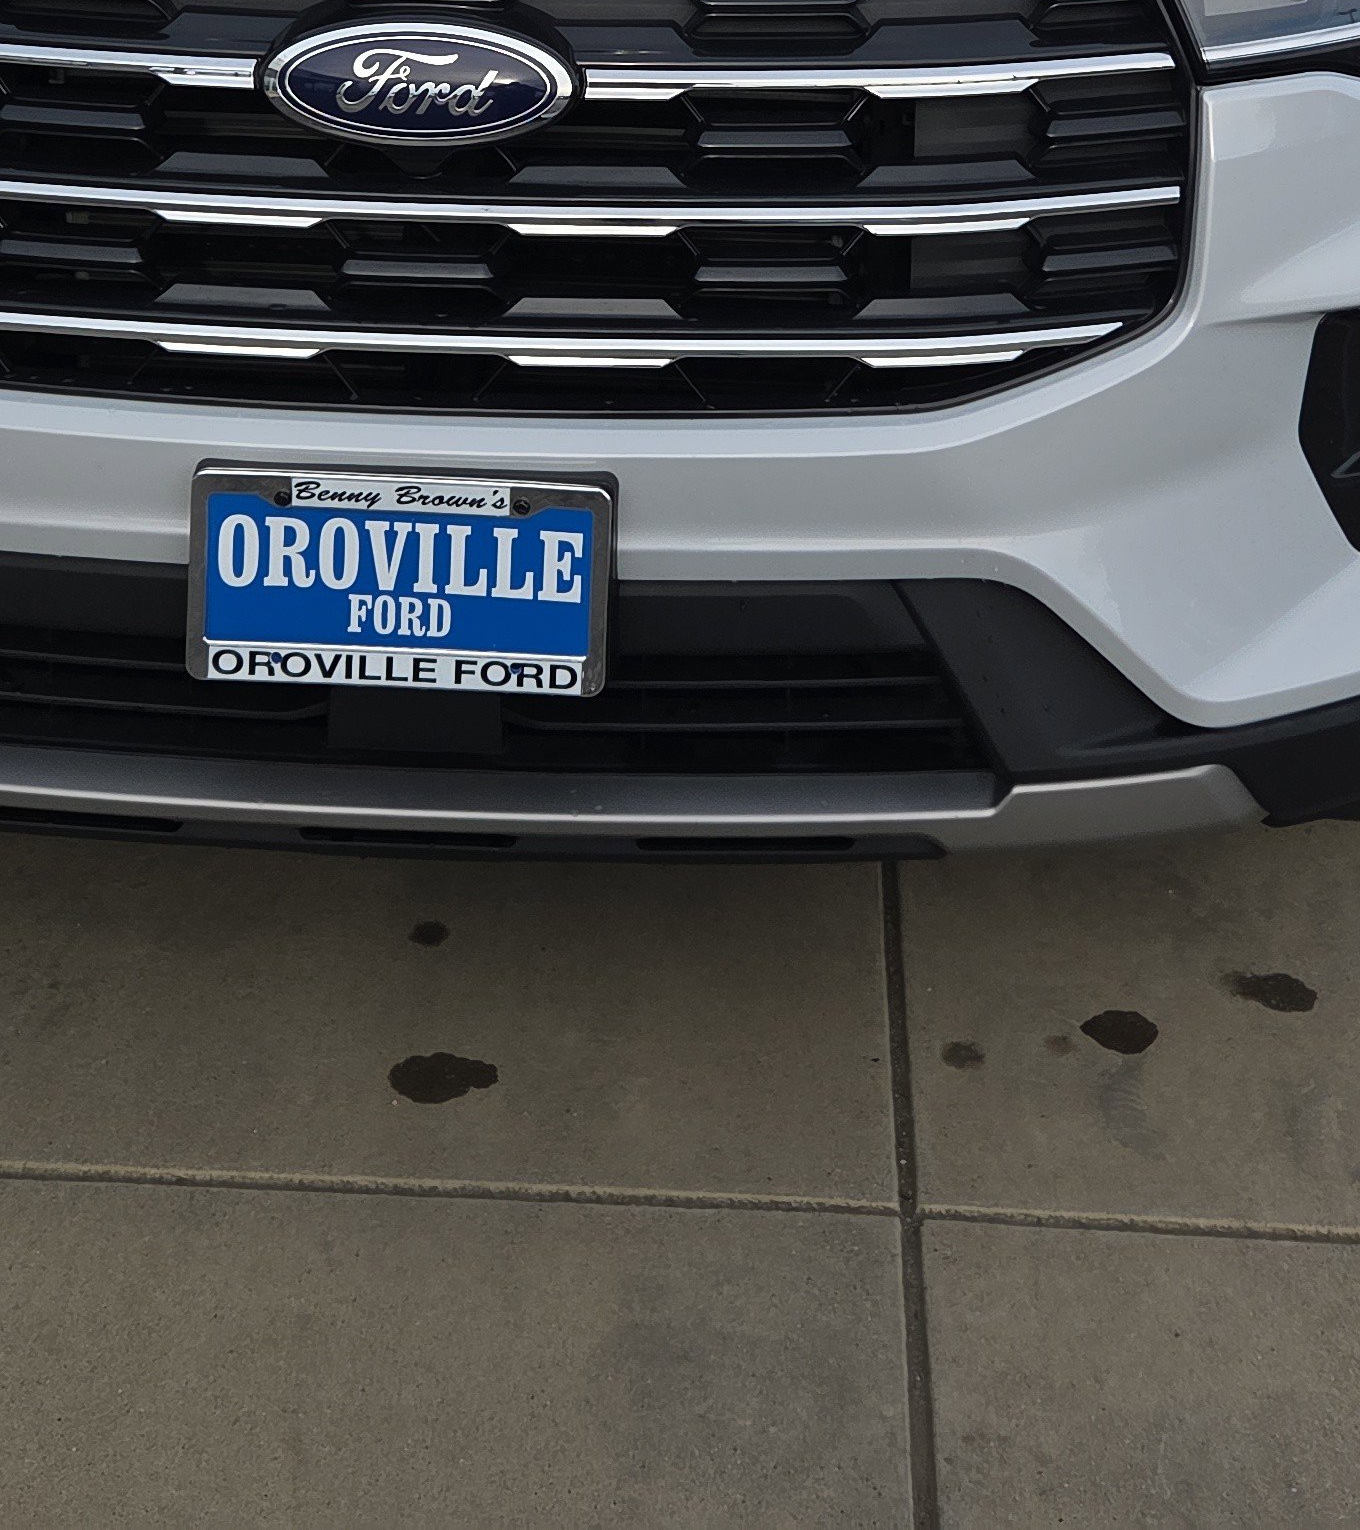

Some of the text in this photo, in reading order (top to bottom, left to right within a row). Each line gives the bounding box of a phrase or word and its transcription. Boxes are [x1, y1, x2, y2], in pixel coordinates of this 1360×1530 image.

[336, 48, 498, 117] Ford
[293, 481, 508, 511] Benny Brown's
[217, 514, 584, 603] OROVILLE
[347, 594, 452, 638] FORD
[211, 649, 578, 690] OROVILLE FORD
